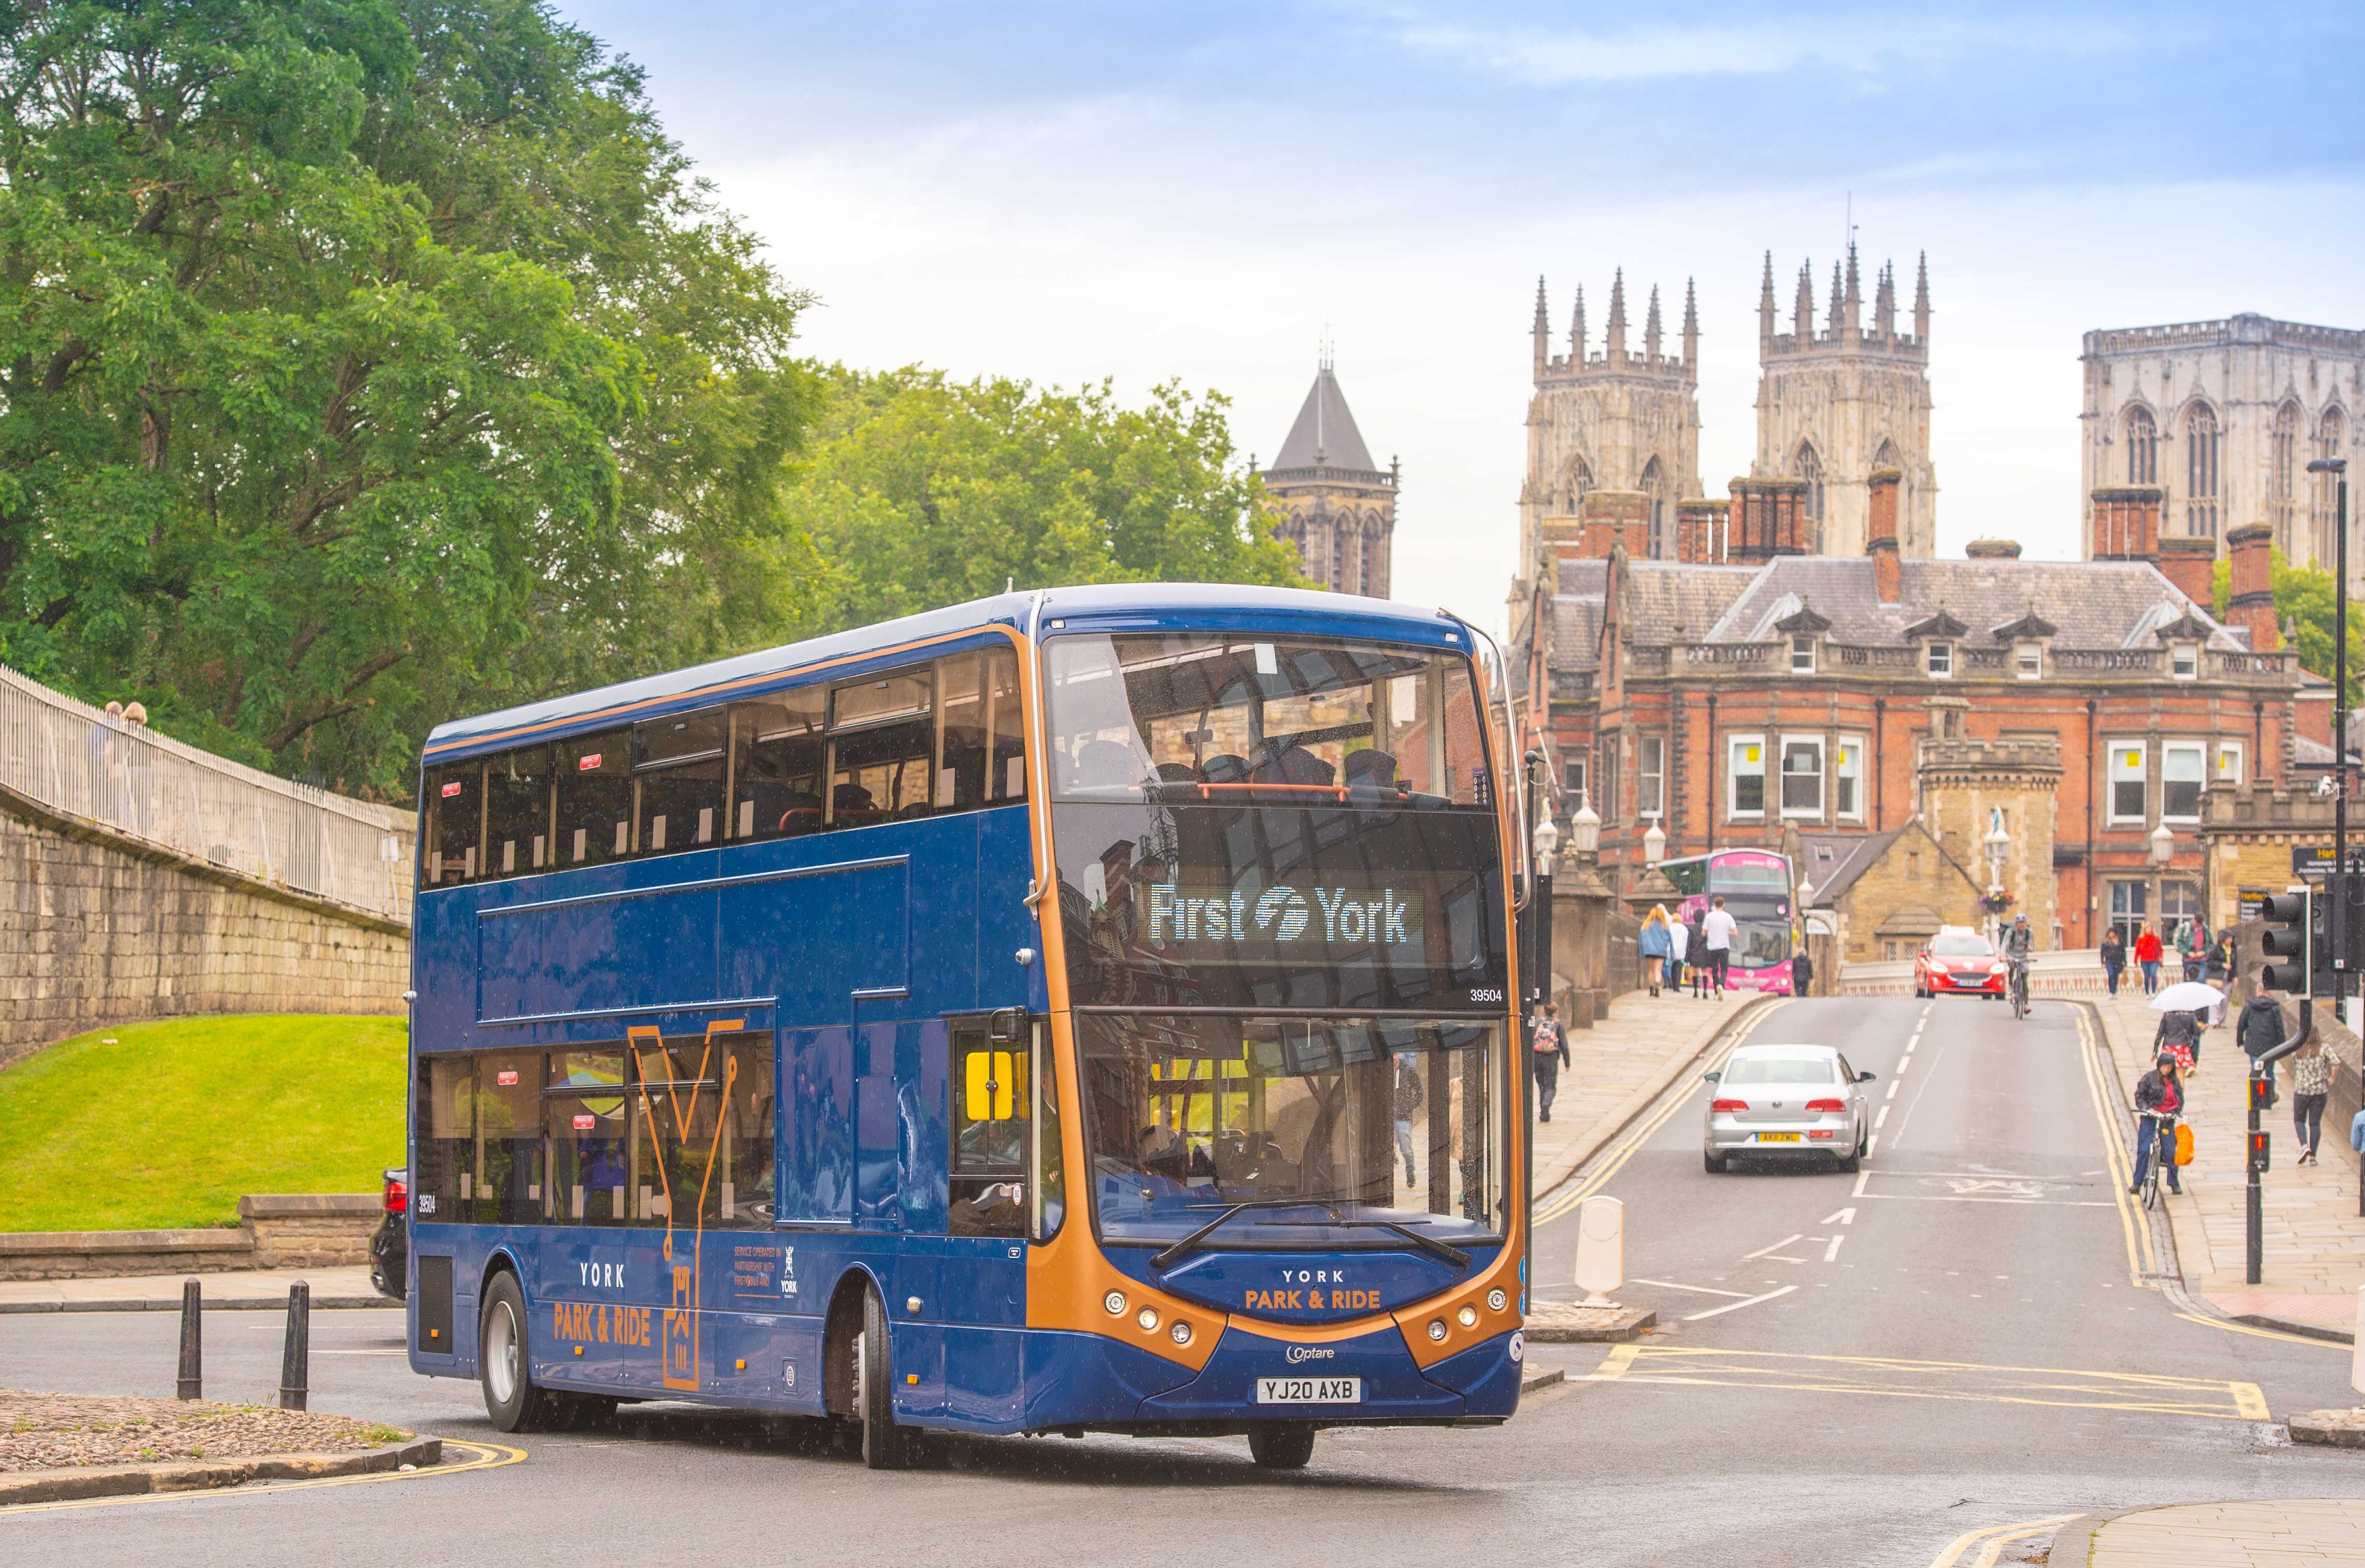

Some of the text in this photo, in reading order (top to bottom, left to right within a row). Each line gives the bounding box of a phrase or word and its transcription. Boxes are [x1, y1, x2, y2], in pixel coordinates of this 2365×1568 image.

[1150, 884, 1407, 943] First York
[1471, 989, 1502, 1001] 39504
[1015, 1190, 1020, 1198] 80
[419, 1194, 435, 1213] 39504
[734, 1246, 781, 1257] SERVICE OPERATED IN
[734, 1261, 775, 1272] PARTNERSHIP WITH
[581, 1263, 624, 1288] YORK
[734, 1275, 747, 1286] FIRST
[759, 1277, 769, 1286] AND
[1283, 1270, 1344, 1282] YORK
[781, 1280, 797, 1293] YORK
[1246, 1290, 1381, 1309] PARK & RIDE
[554, 1303, 651, 1347] PARK & RIDE
[1294, 1347, 1334, 1362] Optare
[1266, 1381, 1353, 1400] YJ20 AXB
